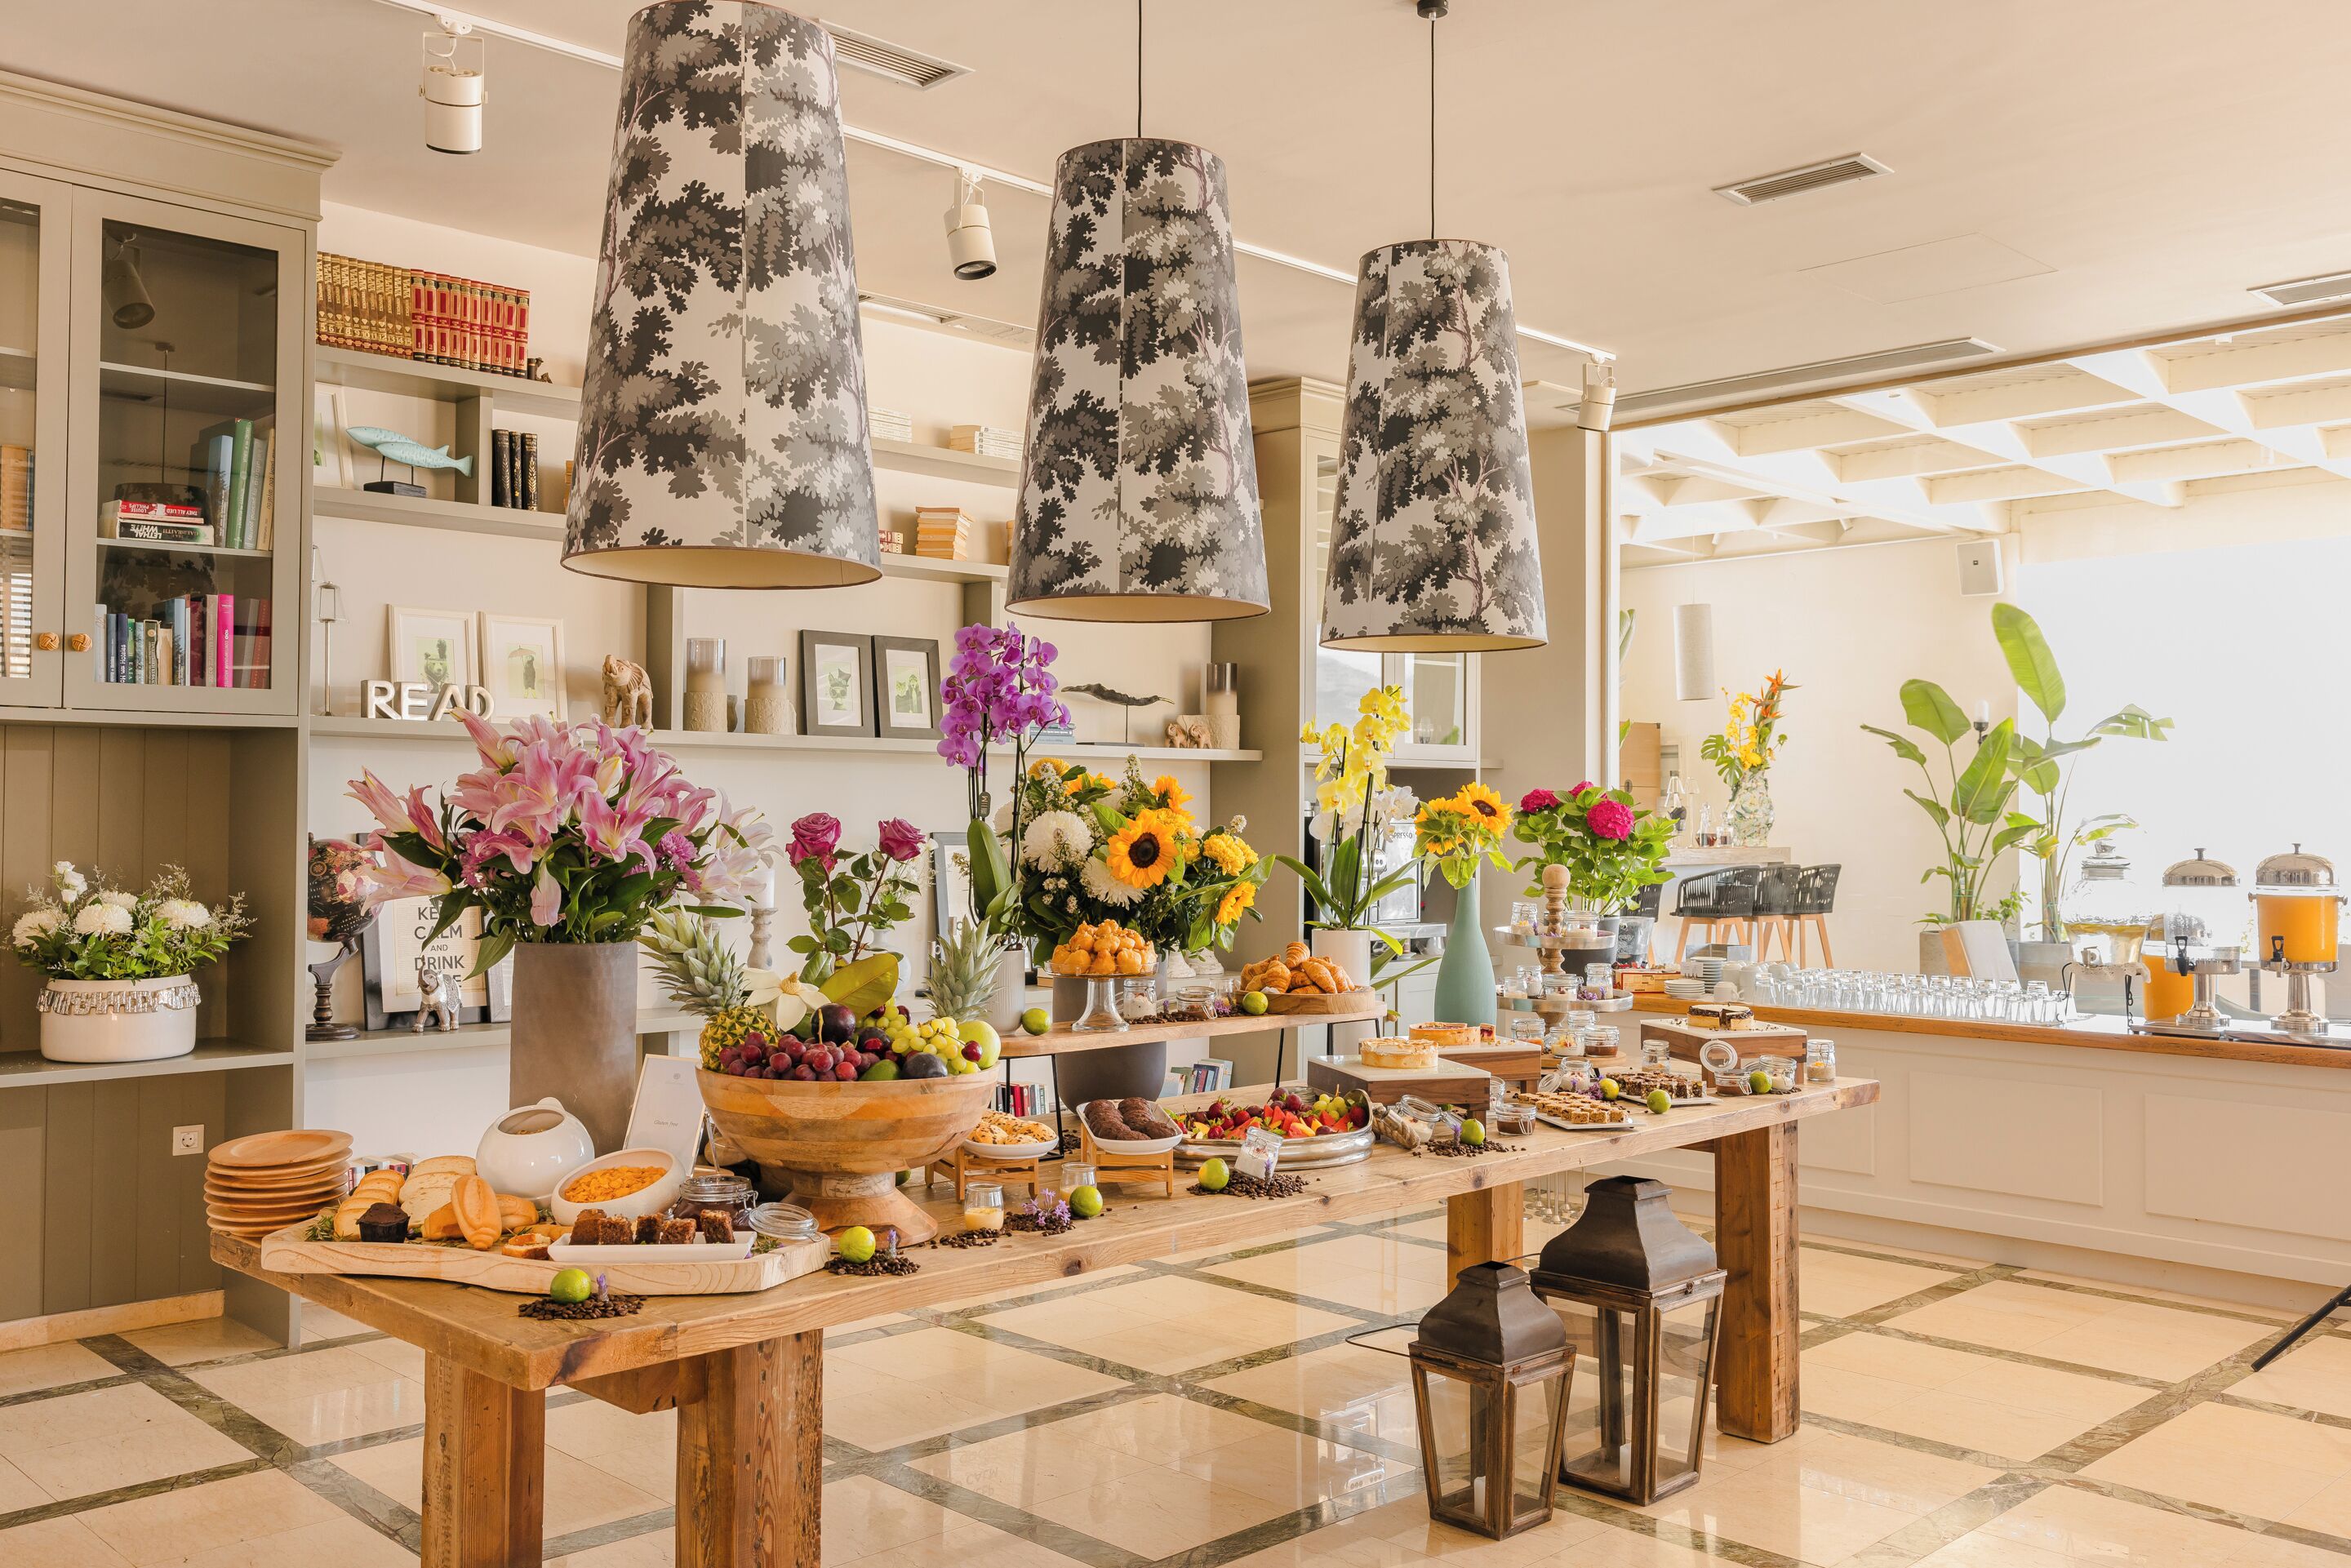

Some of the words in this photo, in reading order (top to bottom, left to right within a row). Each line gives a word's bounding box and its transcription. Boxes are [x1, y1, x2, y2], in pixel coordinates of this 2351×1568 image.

[131, 524, 158, 533] WHITE
[134, 531, 162, 539] LETHAL
[361, 680, 495, 722] READ
[415, 955, 465, 971] DRINK
